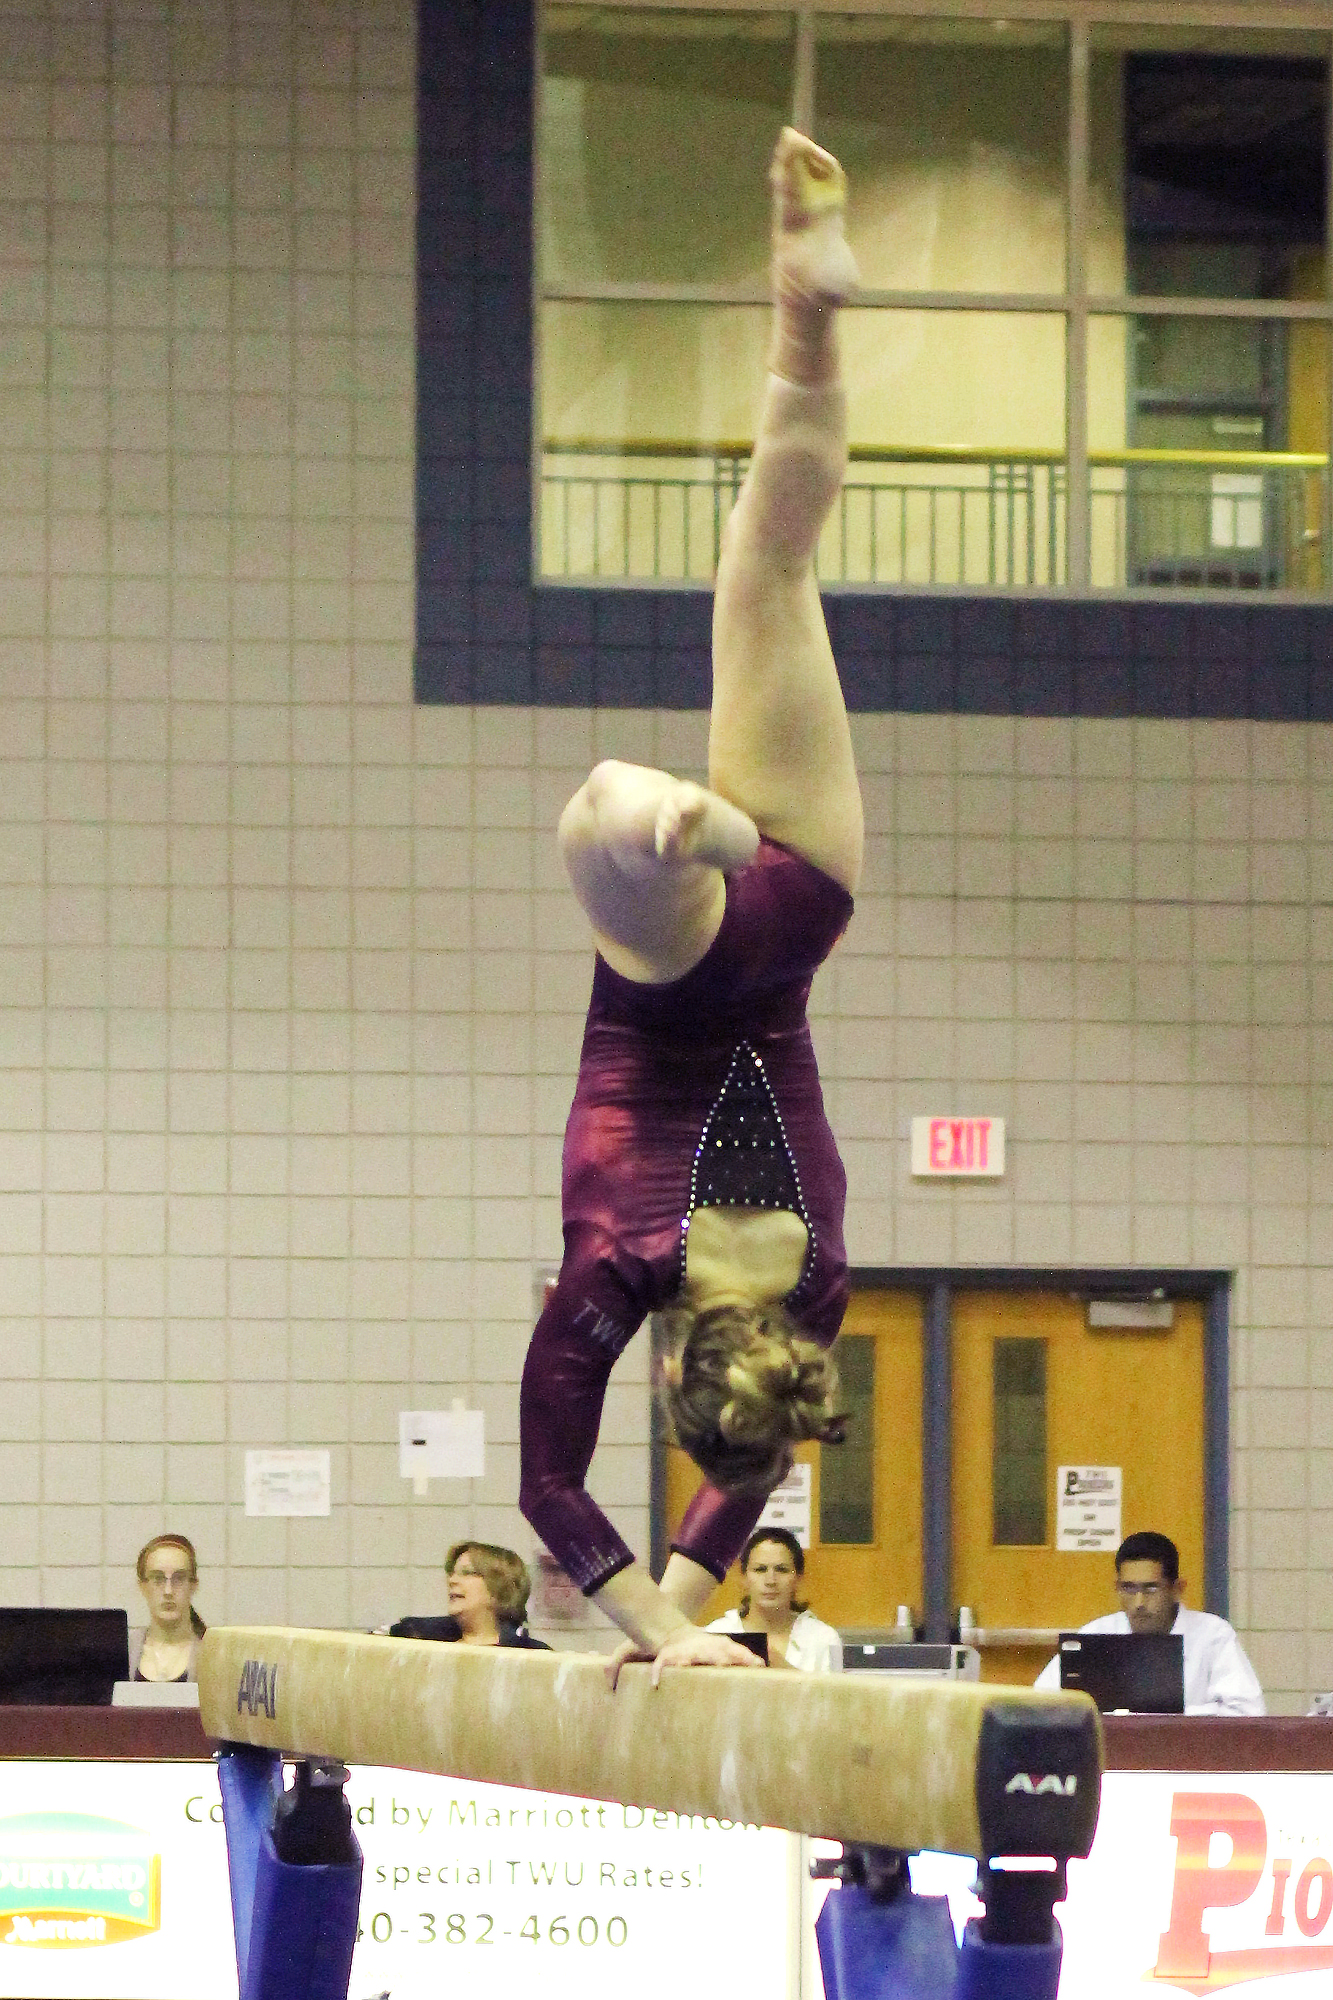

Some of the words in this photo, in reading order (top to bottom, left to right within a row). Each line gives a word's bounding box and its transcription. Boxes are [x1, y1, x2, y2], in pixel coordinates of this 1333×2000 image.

[929, 1118, 992, 1170] EXIT
[1005, 1772, 1077, 1796] AAI
[392, 1797, 433, 1834] by
[449, 1799, 606, 1829] Marriott
[375, 1858, 492, 1891] special
[505, 1860, 584, 1887] TWU
[600, 1862, 702, 1889] Rates!
